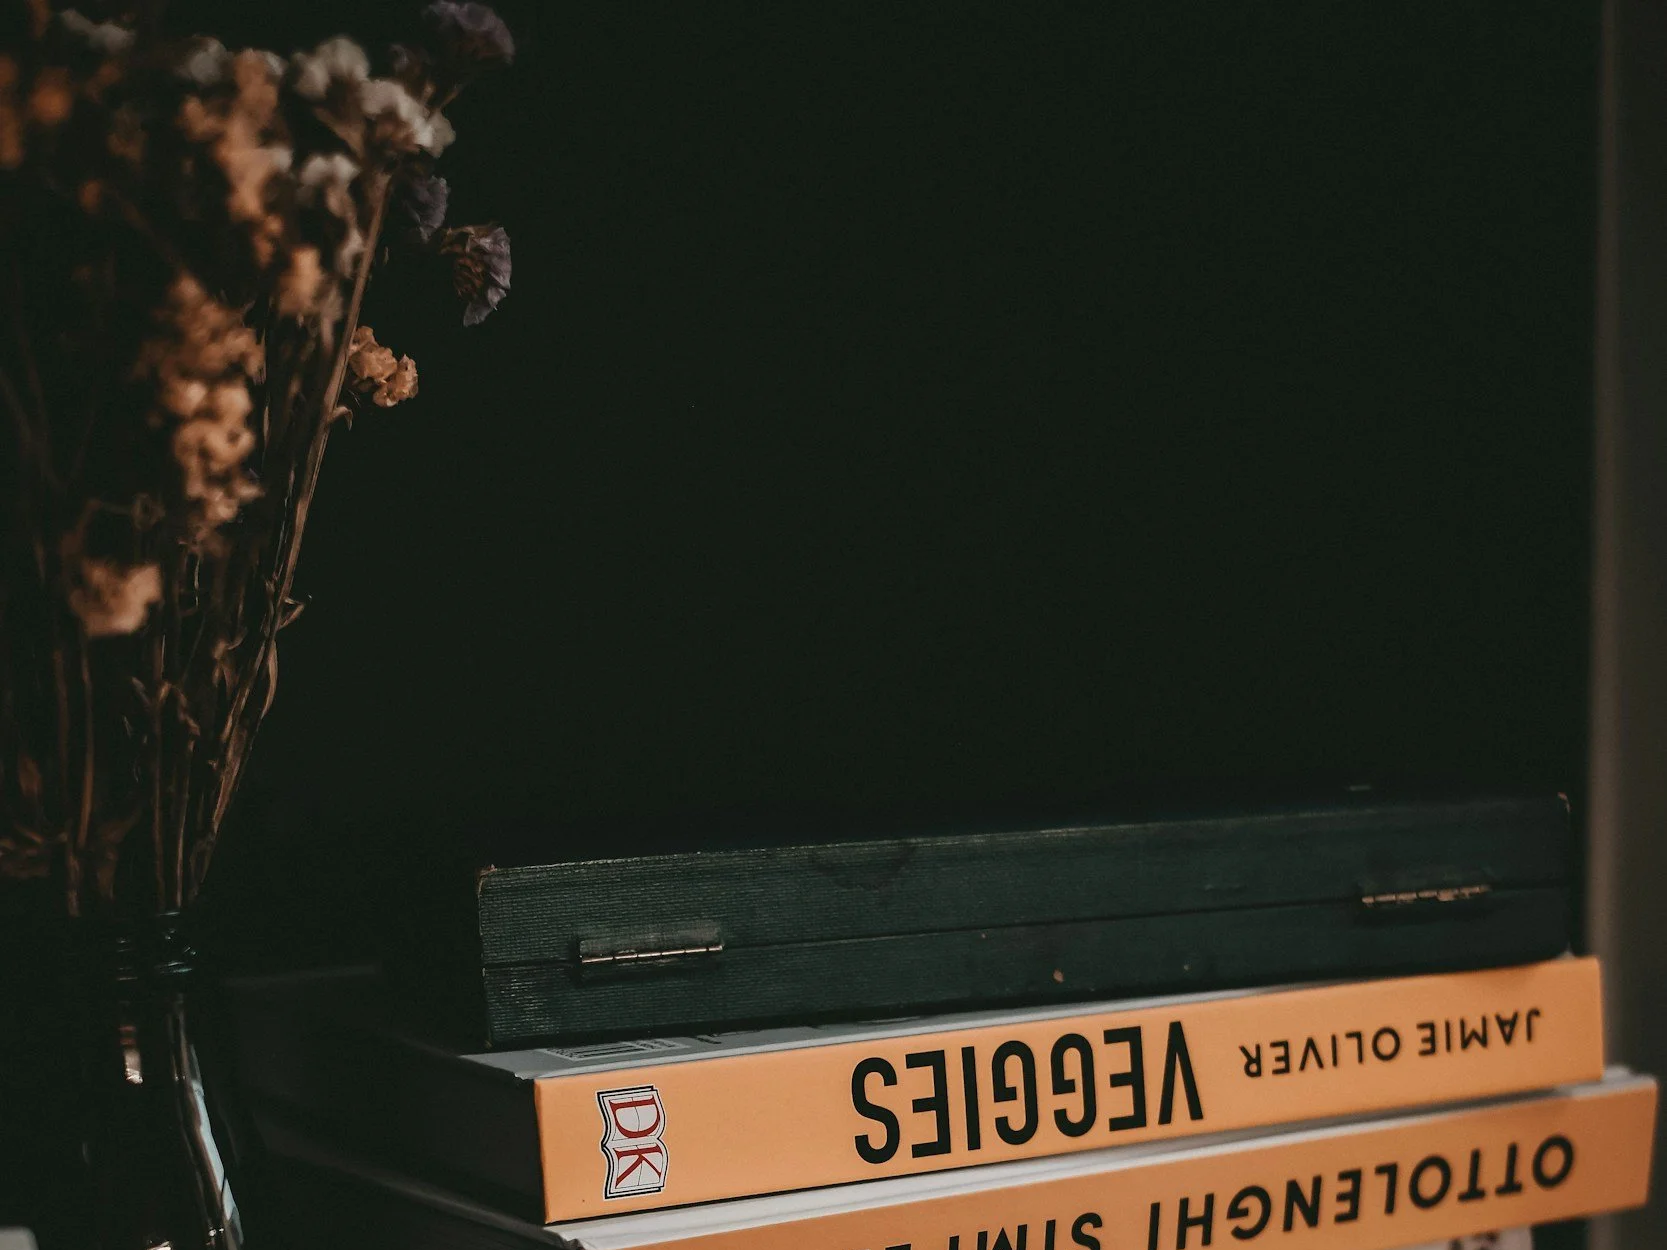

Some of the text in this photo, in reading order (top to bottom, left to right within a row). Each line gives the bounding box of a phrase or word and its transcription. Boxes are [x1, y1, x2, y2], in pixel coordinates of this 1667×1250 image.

[608, 1095, 664, 1188] DK
[851, 1007, 1541, 1164] JAMIE OLIVER VEGGIES
